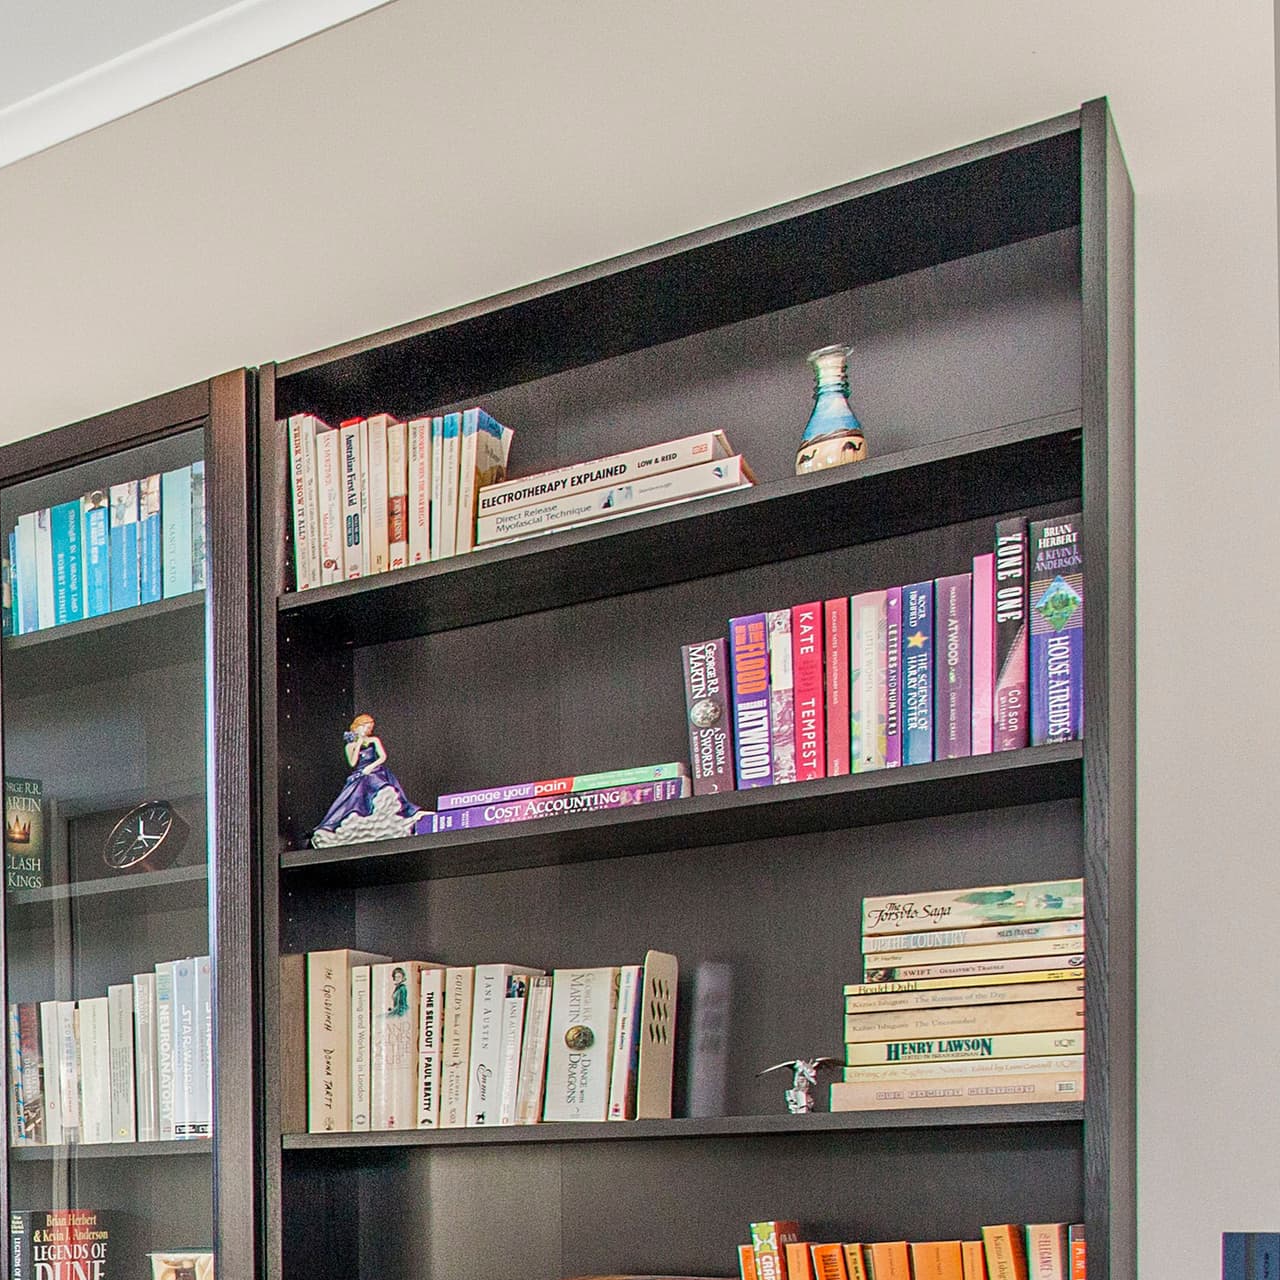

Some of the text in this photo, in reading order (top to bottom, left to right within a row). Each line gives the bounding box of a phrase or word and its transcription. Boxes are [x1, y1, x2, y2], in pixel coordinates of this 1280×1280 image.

[481, 464, 627, 509] ELECTROTHERAPY EXPLAINED
[495, 504, 592, 534] Myofascial Technique
[524, 503, 558, 519] Release
[1038, 534, 1078, 549] HERBERT
[57, 552, 65, 585] ROBERT
[997, 587, 1024, 623] ONE
[947, 618, 959, 666] ATWOOD
[689, 645, 706, 700] MARTIN
[799, 612, 817, 768] KATE TEMPEST
[907, 656, 918, 731] HARRY POTTER
[1048, 636, 1070, 736] HOUSE ATREIDES
[1007, 689, 1020, 732] Colson
[700, 728, 714, 777] SWORDS
[738, 709, 770, 779] ATWOOD
[450, 780, 567, 805] manage your pain
[484, 791, 621, 822] COST ACCOUNTING
[8, 872, 42, 888] KINGS
[903, 968, 931, 977] SWIFT
[569, 974, 584, 1023] MARTIN
[482, 1008, 492, 1050] AUSTEN
[886, 1041, 933, 1061] HENRY
[937, 1037, 993, 1056] LAWSON
[159, 1004, 174, 1119] NEUROANATOMY
[181, 1004, 194, 1097] STAR WARS
[423, 991, 434, 1112] THE SELLOUT PAUL BEATTY
[476, 1063, 493, 1101] Emma
[566, 1053, 581, 1104] DRAGONS
[33, 1228, 108, 1242] & Kevin Anderson
[46, 1212, 97, 1227] Brian Herbert
[33, 1242, 107, 1262] LEGENDS OF
